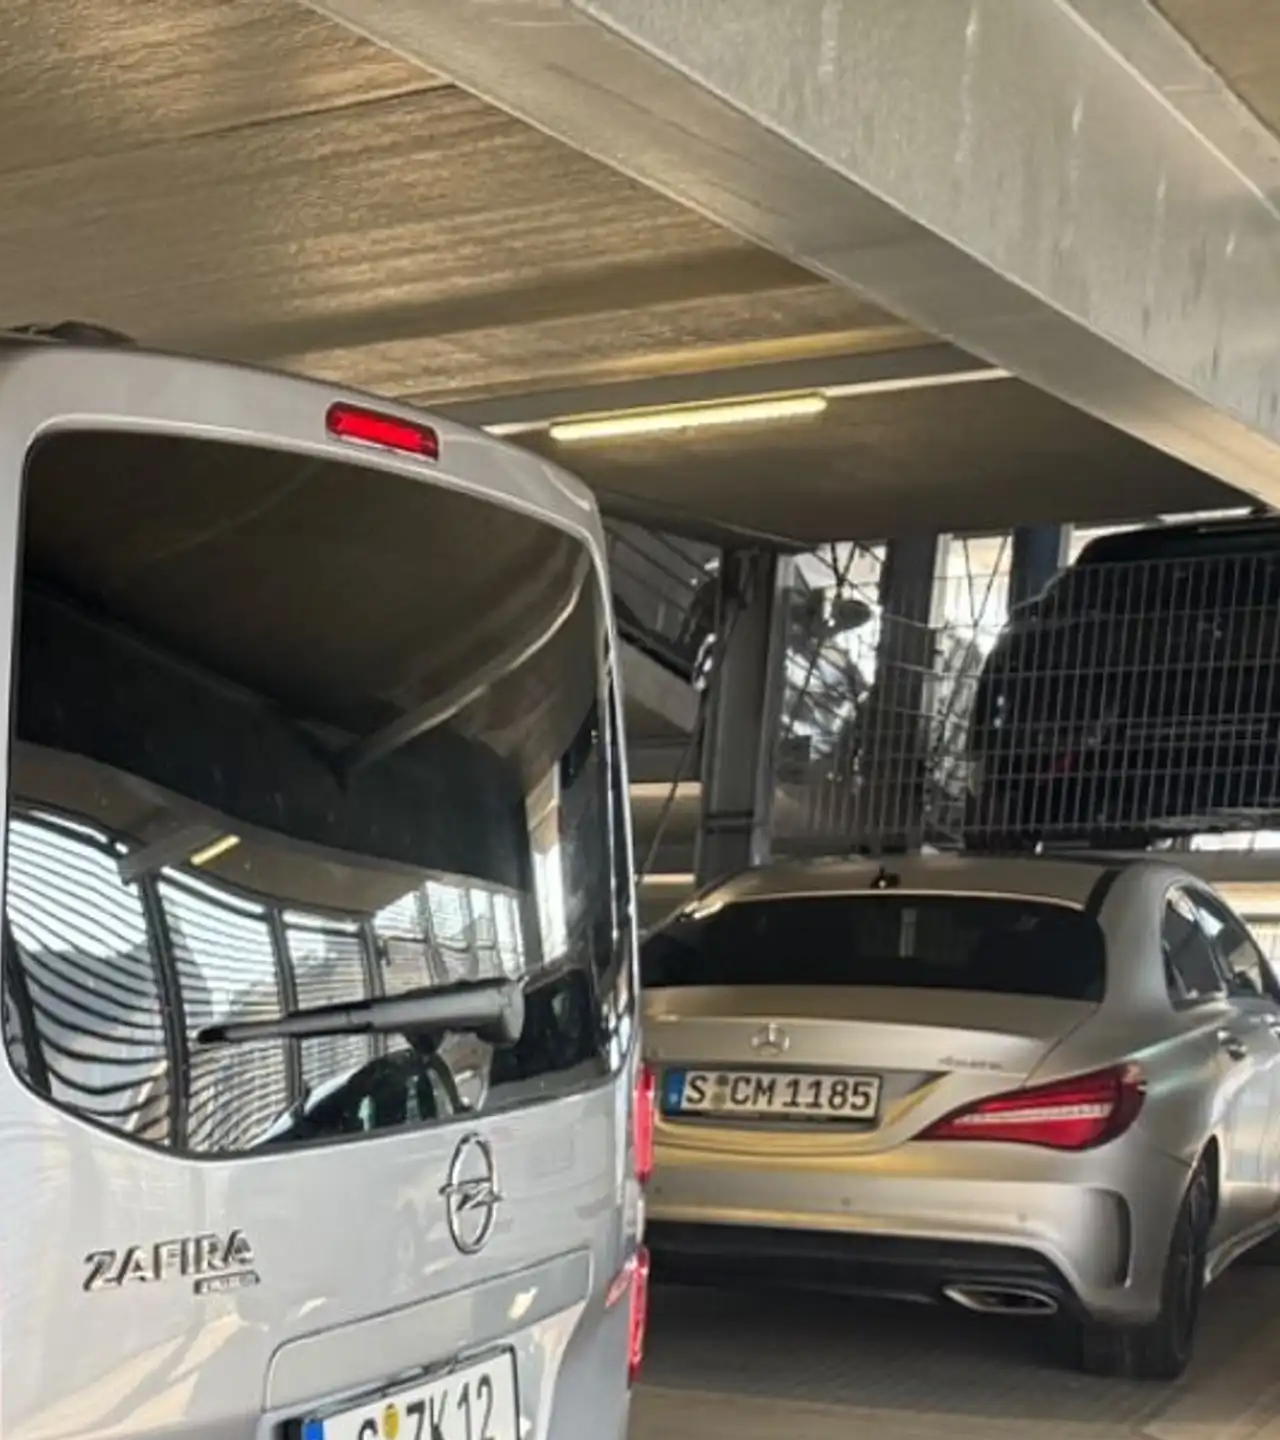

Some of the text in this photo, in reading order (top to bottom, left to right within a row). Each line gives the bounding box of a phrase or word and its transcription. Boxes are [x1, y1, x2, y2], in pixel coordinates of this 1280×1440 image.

[686, 1075, 873, 1111] S CM 1185
[83, 1228, 255, 1292] ZAFIRA
